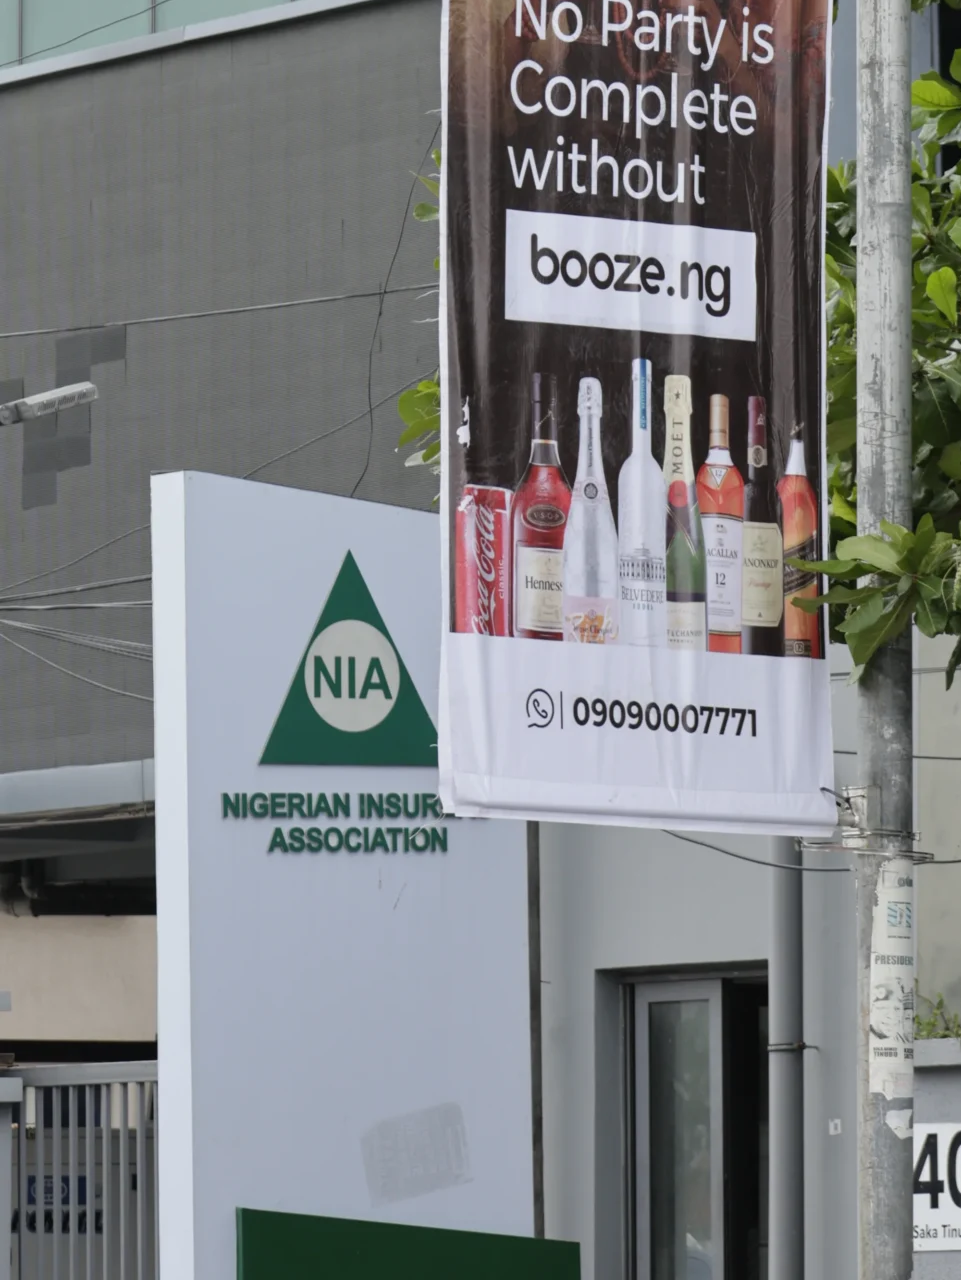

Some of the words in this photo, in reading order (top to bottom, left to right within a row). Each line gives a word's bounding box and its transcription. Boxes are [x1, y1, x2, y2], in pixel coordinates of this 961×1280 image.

[741, 6, 775, 64] is
[510, 59, 757, 139] Complete
[507, 136, 706, 205] without
[530, 233, 731, 318] booze.ng
[706, 548, 739, 559] ACALLAN
[525, 575, 563, 592] Henness
[715, 572, 726, 586] 12
[313, 655, 394, 700] NIA
[573, 696, 758, 738] 09090007771
[221, 792, 351, 819] NIGERIAN
[358, 792, 447, 819] INSUR
[267, 826, 449, 854] ASSOCIATION
[913, 1224, 938, 1239] Saka
